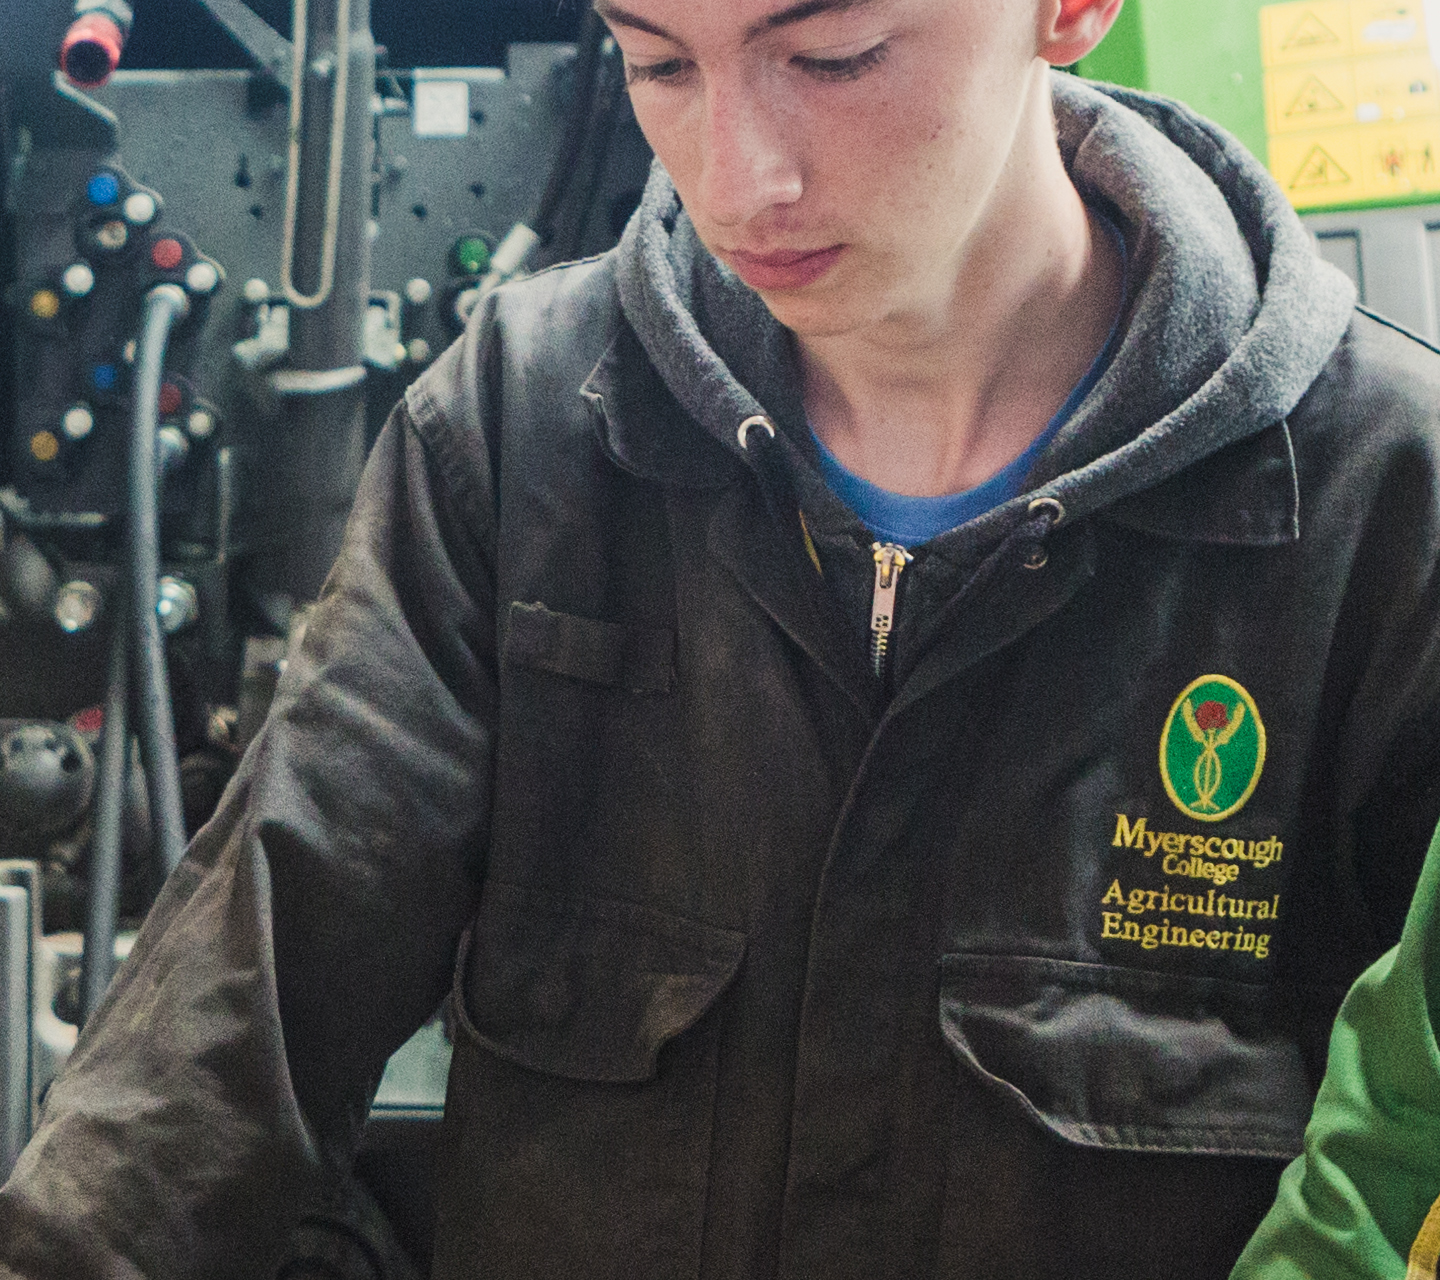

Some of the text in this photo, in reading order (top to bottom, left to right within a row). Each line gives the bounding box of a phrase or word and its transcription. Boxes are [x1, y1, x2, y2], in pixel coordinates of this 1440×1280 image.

[1112, 813, 1283, 868] Myerscough
[1162, 854, 1240, 885] College
[1101, 879, 1280, 920] Agricultural
[1101, 912, 1270, 959] Engineering
